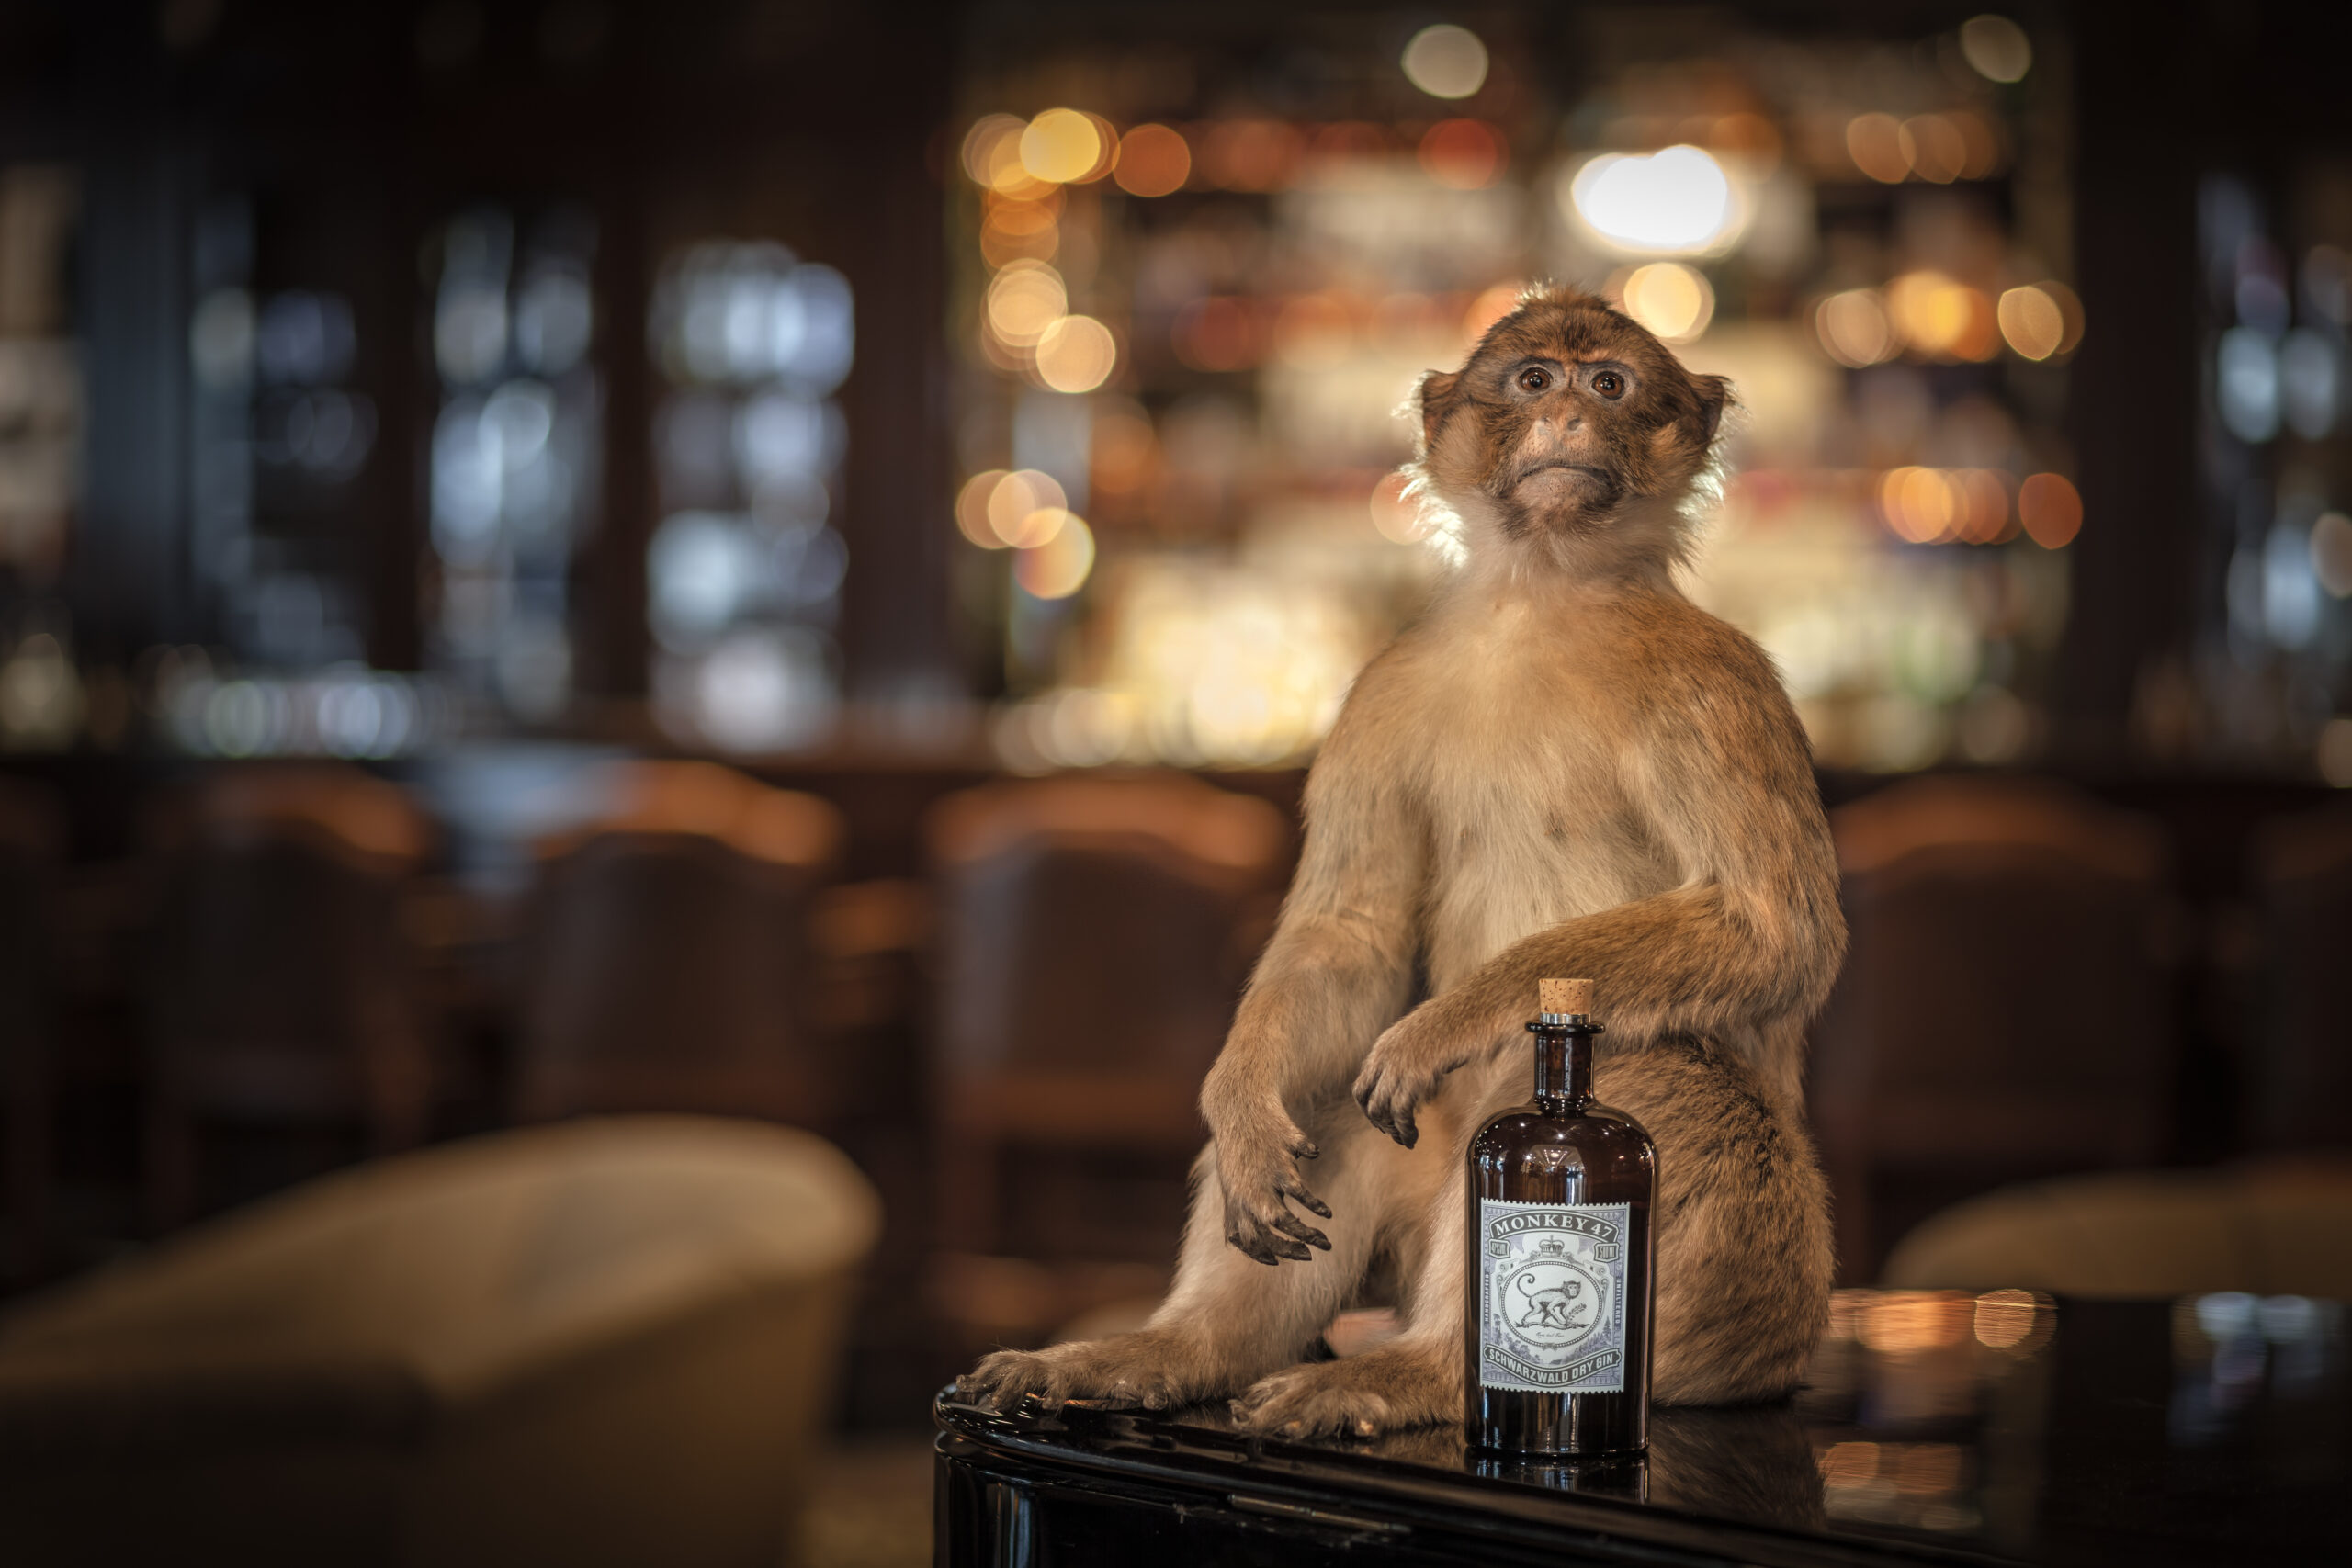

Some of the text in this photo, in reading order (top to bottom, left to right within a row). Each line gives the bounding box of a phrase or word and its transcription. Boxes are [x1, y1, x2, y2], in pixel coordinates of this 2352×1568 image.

[1494, 1214, 1613, 1238] MONKEY 47
[1489, 1349, 1613, 1384] SCHWARZWALD DRY GIN
